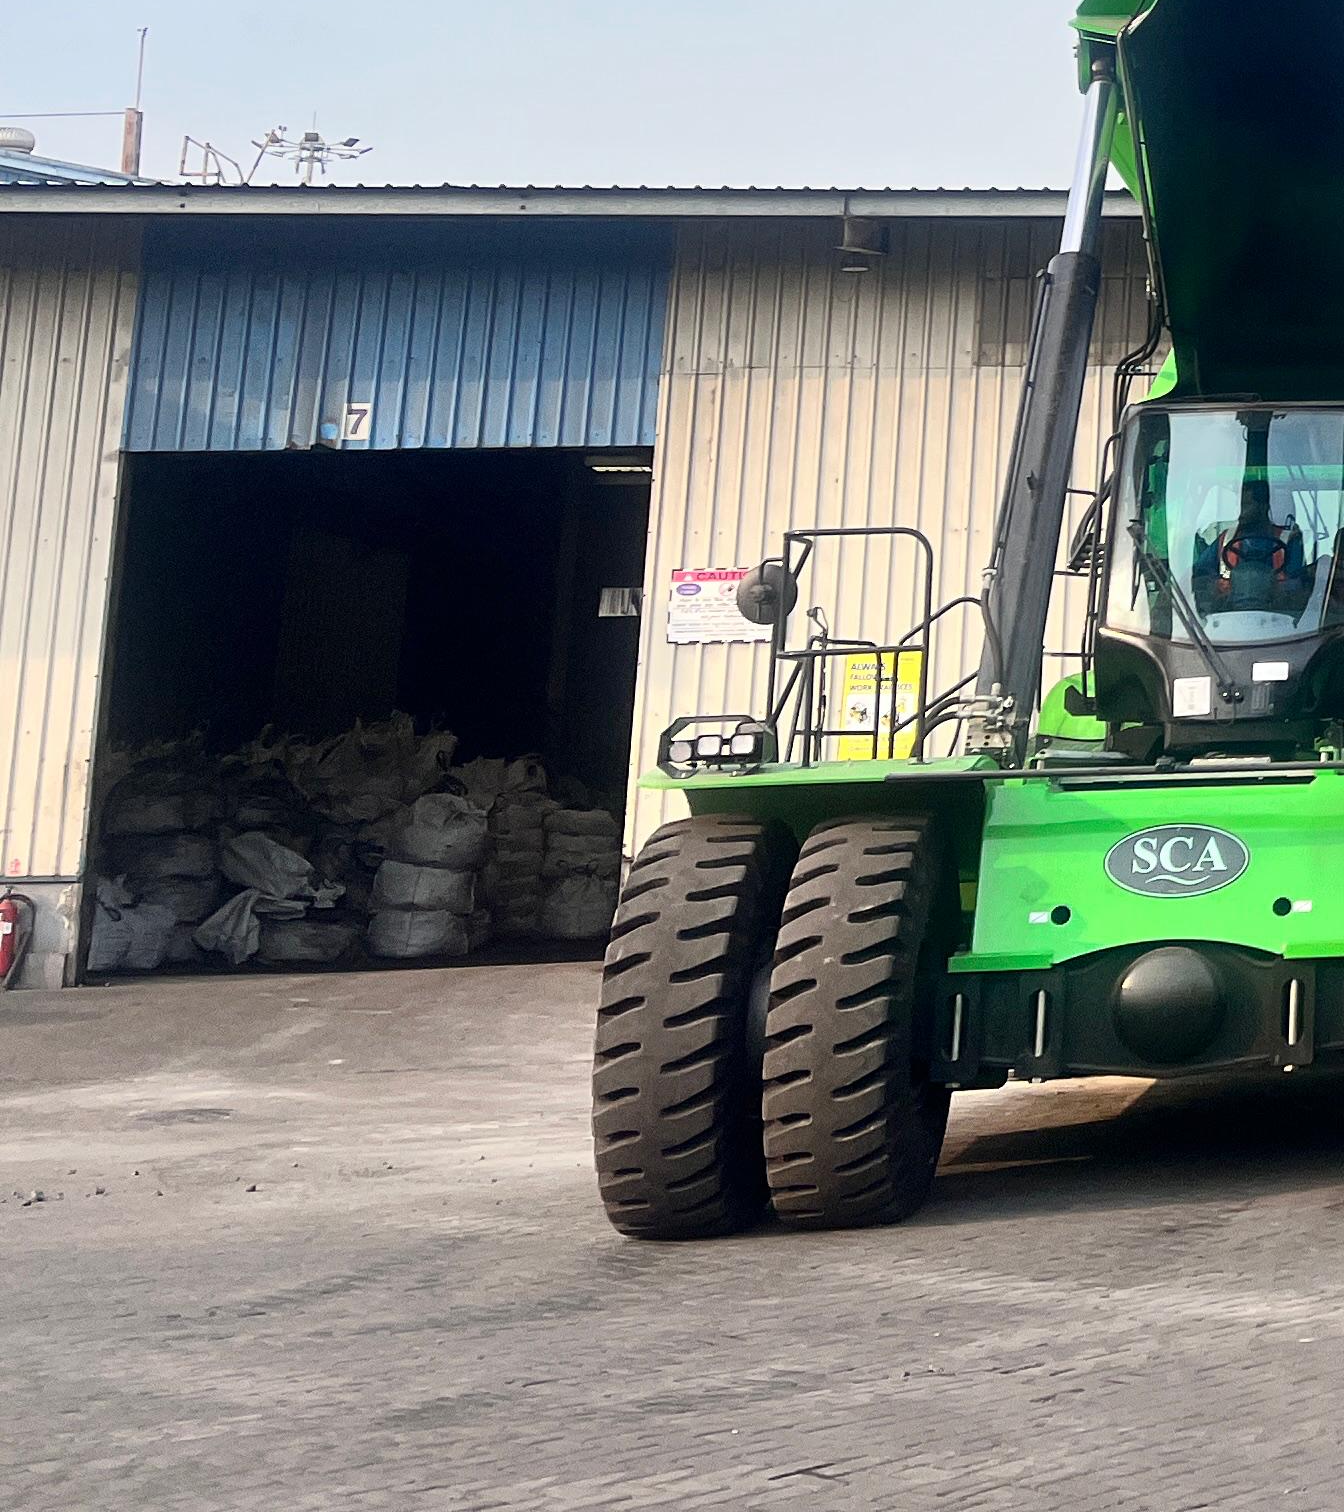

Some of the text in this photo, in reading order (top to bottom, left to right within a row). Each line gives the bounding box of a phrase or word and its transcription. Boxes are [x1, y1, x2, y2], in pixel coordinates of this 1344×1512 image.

[347, 408, 368, 435] 7
[696, 571, 748, 581] CAUTI
[851, 663, 886, 671] ALWAS
[1131, 836, 1228, 874] SCA
